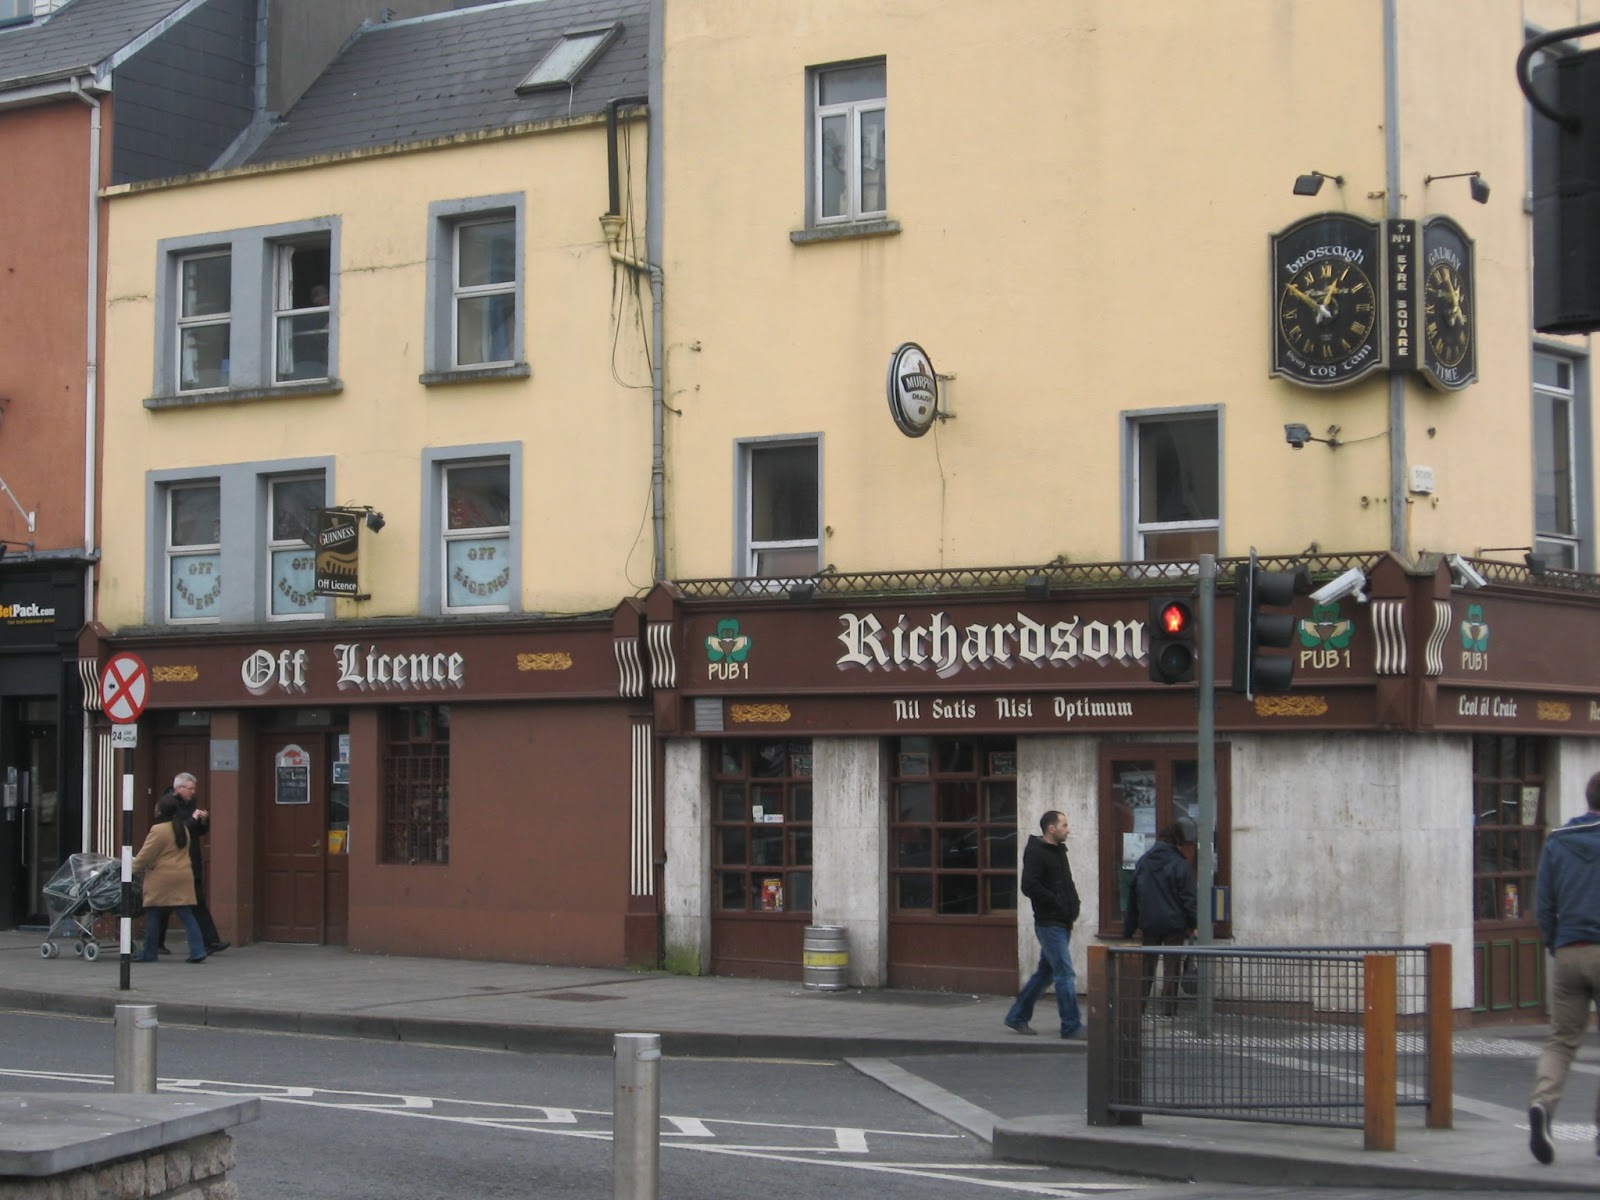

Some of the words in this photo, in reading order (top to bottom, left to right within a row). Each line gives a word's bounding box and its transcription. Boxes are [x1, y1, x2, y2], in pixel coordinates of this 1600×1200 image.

[1428, 247, 1461, 271] GALWAY
[1397, 255, 1407, 291] EYRE
[1397, 300, 1409, 356] SQUARE
[1435, 362, 1459, 381] TIME
[320, 526, 356, 546] GUINNESS
[467, 547, 496, 560] OFF
[189, 562, 213, 575] OFF
[317, 579, 330, 589] Off
[331, 580, 357, 591] Licence
[241, 649, 306, 690] Off
[333, 643, 464, 688] Licence
[893, 697, 920, 721] Nil
[932, 699, 977, 719] Satis
[996, 697, 1034, 721] Nisi
[1054, 697, 1134, 720] Optimum
[1459, 694, 1478, 716] Ceol
[112, 731, 122, 741] 24
